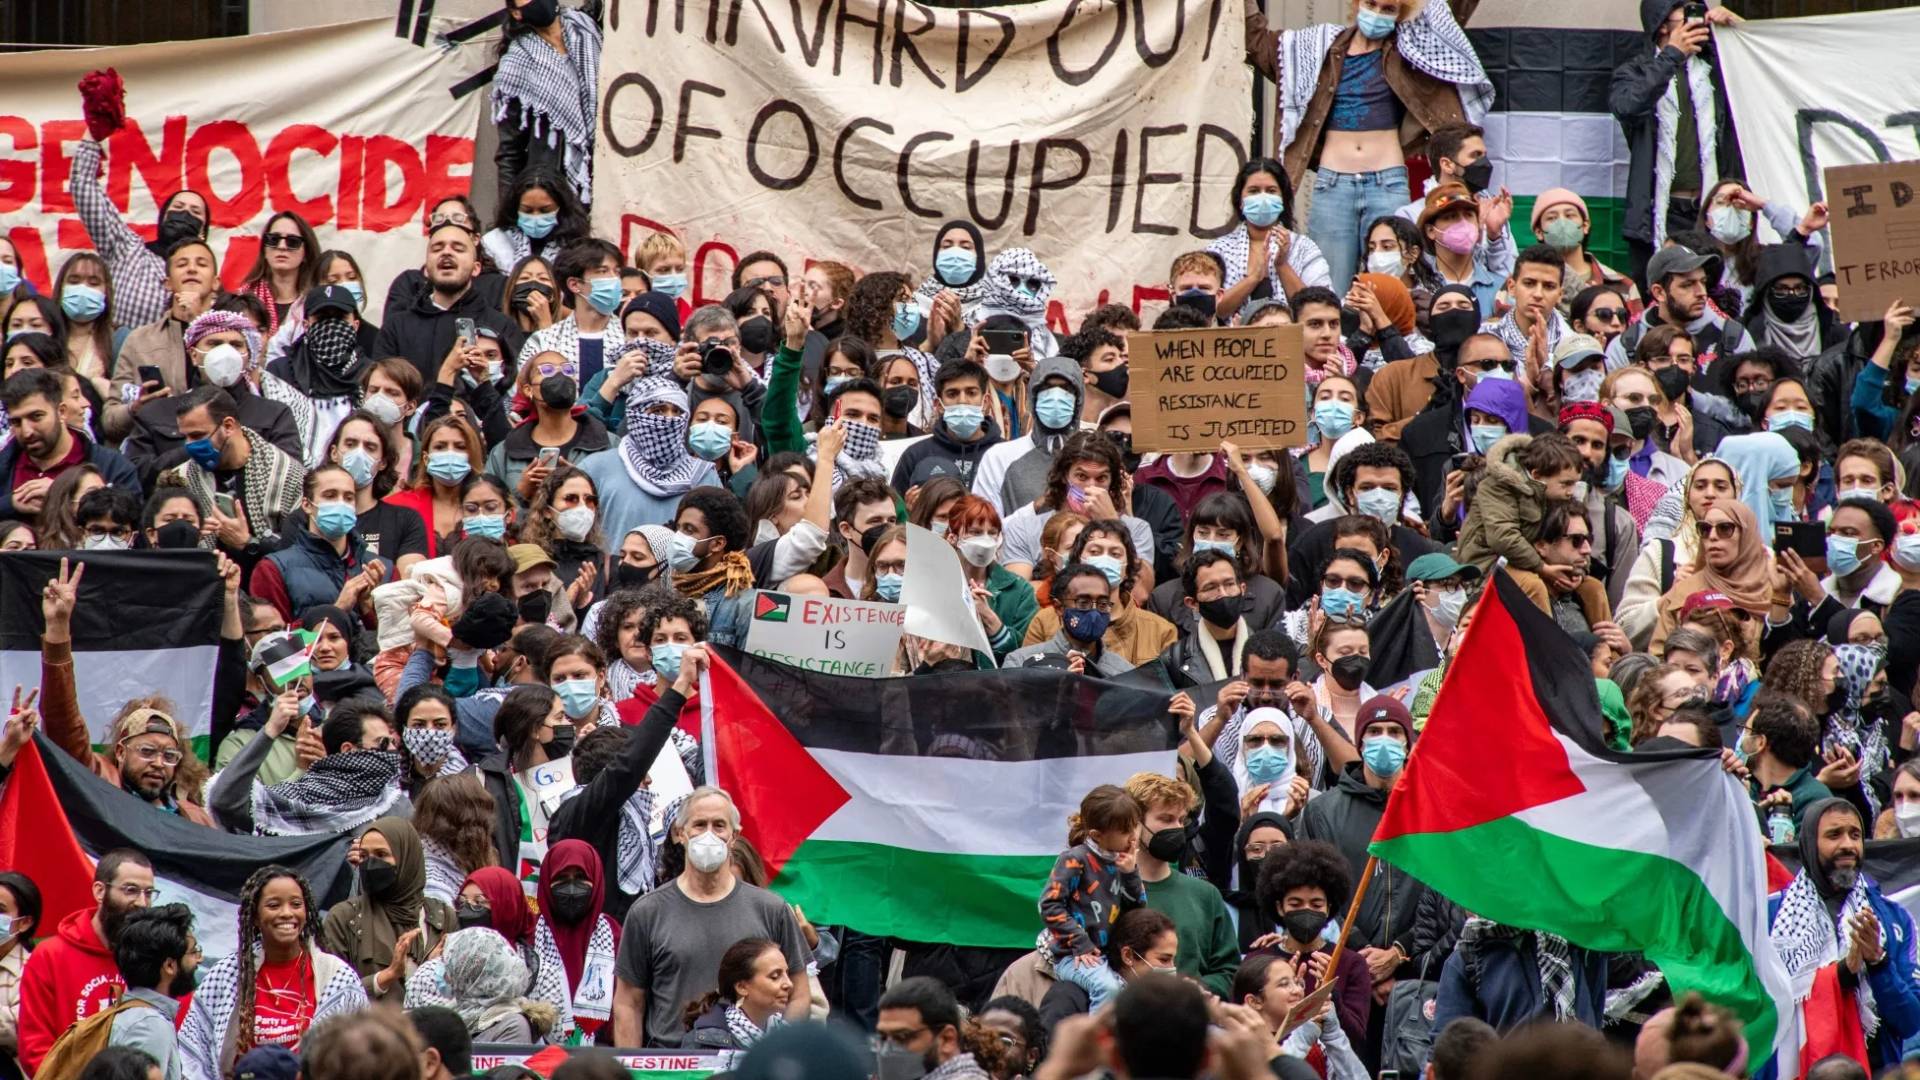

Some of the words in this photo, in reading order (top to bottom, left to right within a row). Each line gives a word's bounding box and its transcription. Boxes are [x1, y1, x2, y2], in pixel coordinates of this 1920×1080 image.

[603, 72, 726, 163] OF
[747, 98, 1247, 239] OCCUPIED
[1155, 339, 1204, 360] WHEN
[1214, 338, 1277, 358] PEOPLE
[1160, 365, 1195, 383] ARE
[1203, 364, 1288, 382] OCCUPIED
[1159, 393, 1262, 412] RESISTANCE
[1168, 425, 1190, 440] IS
[1200, 418, 1296, 439] JUSTIFIED
[803, 600, 905, 626] EXISTENCE
[824, 630, 846, 650] IS
